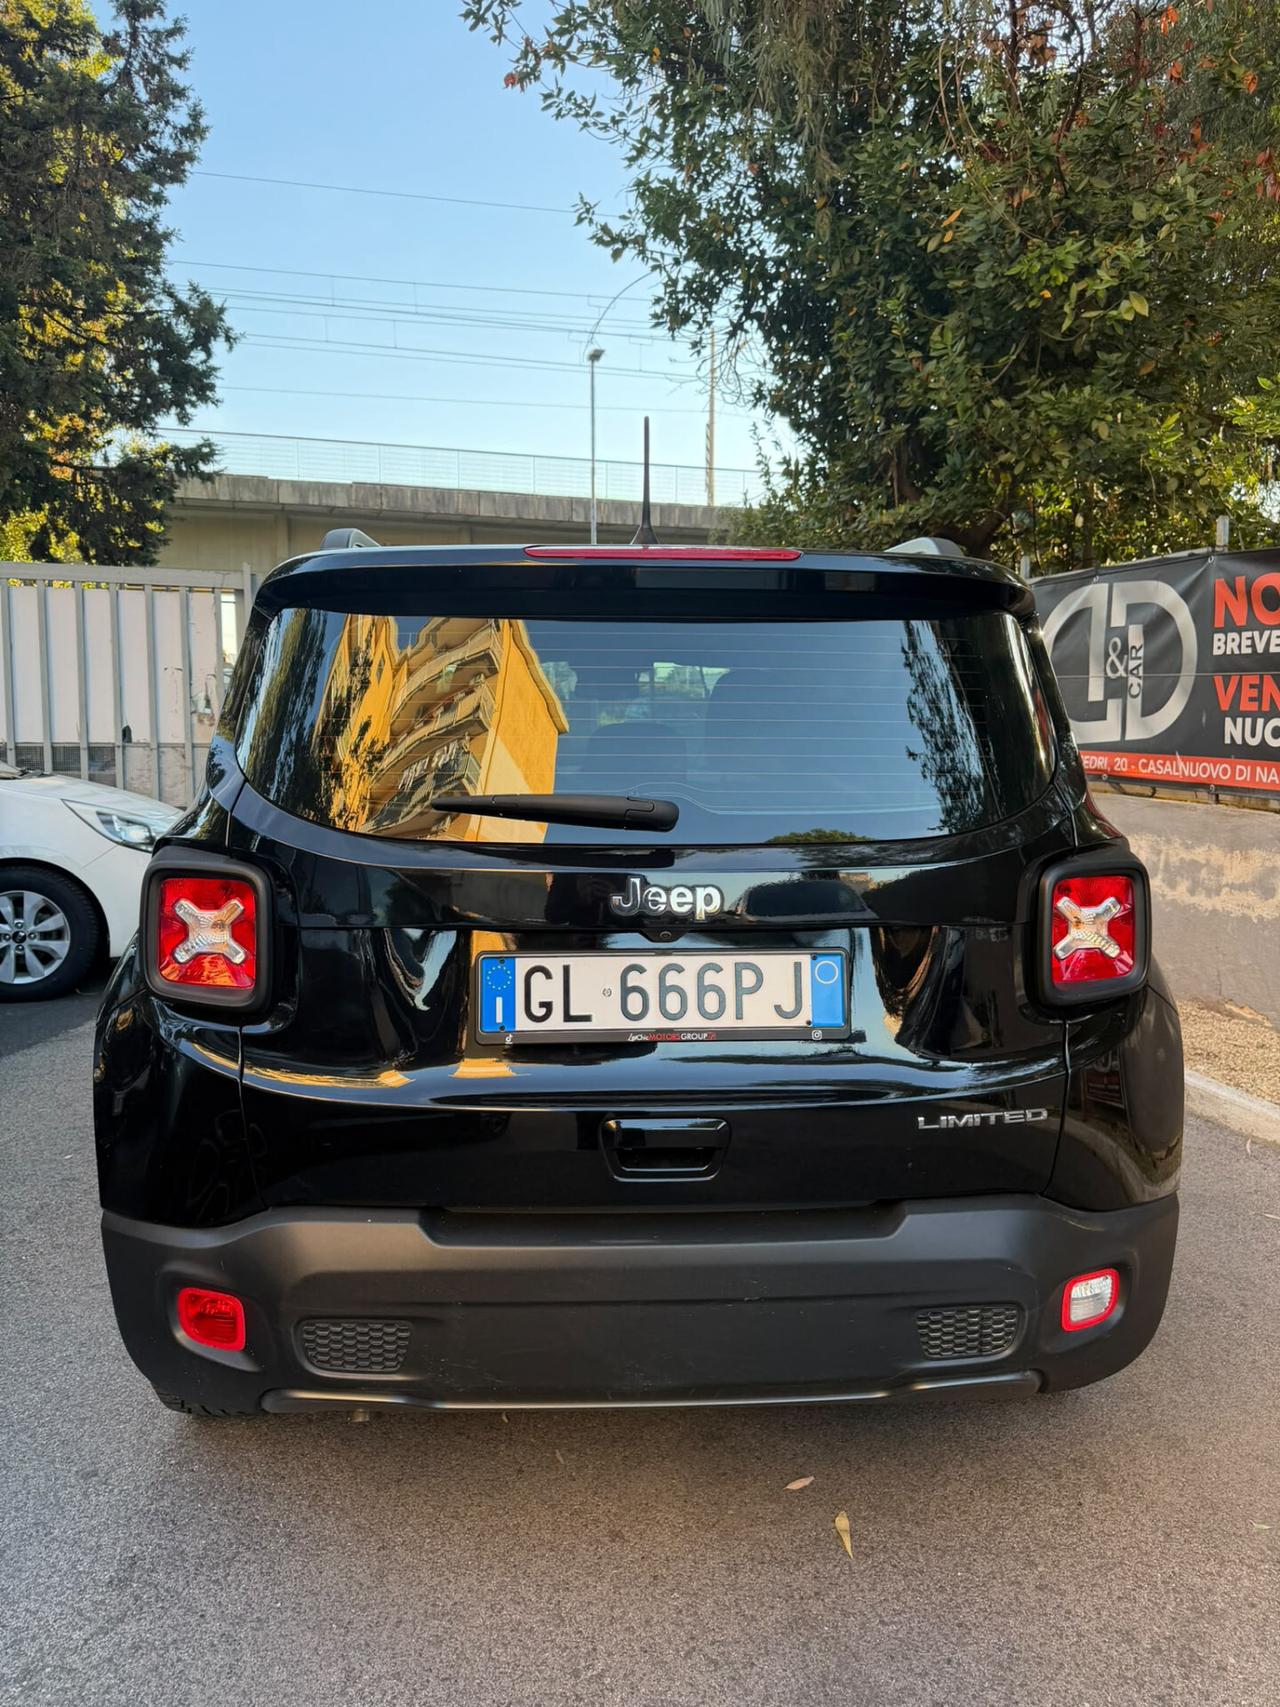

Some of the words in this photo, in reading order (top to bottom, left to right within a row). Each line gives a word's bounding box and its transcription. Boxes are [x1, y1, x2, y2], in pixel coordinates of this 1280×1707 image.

[1212, 629, 1280, 656] BREVE
[1128, 644, 1144, 700] CAR
[1113, 757, 1128, 772] 20
[1138, 758, 1231, 781] CASALNUOVO
[1235, 764, 1251, 781] DI
[611, 877, 722, 921] Jeep
[523, 964, 593, 1023] GL
[619, 961, 803, 1021] 666PJ
[917, 1107, 1048, 1130] LIMITED
